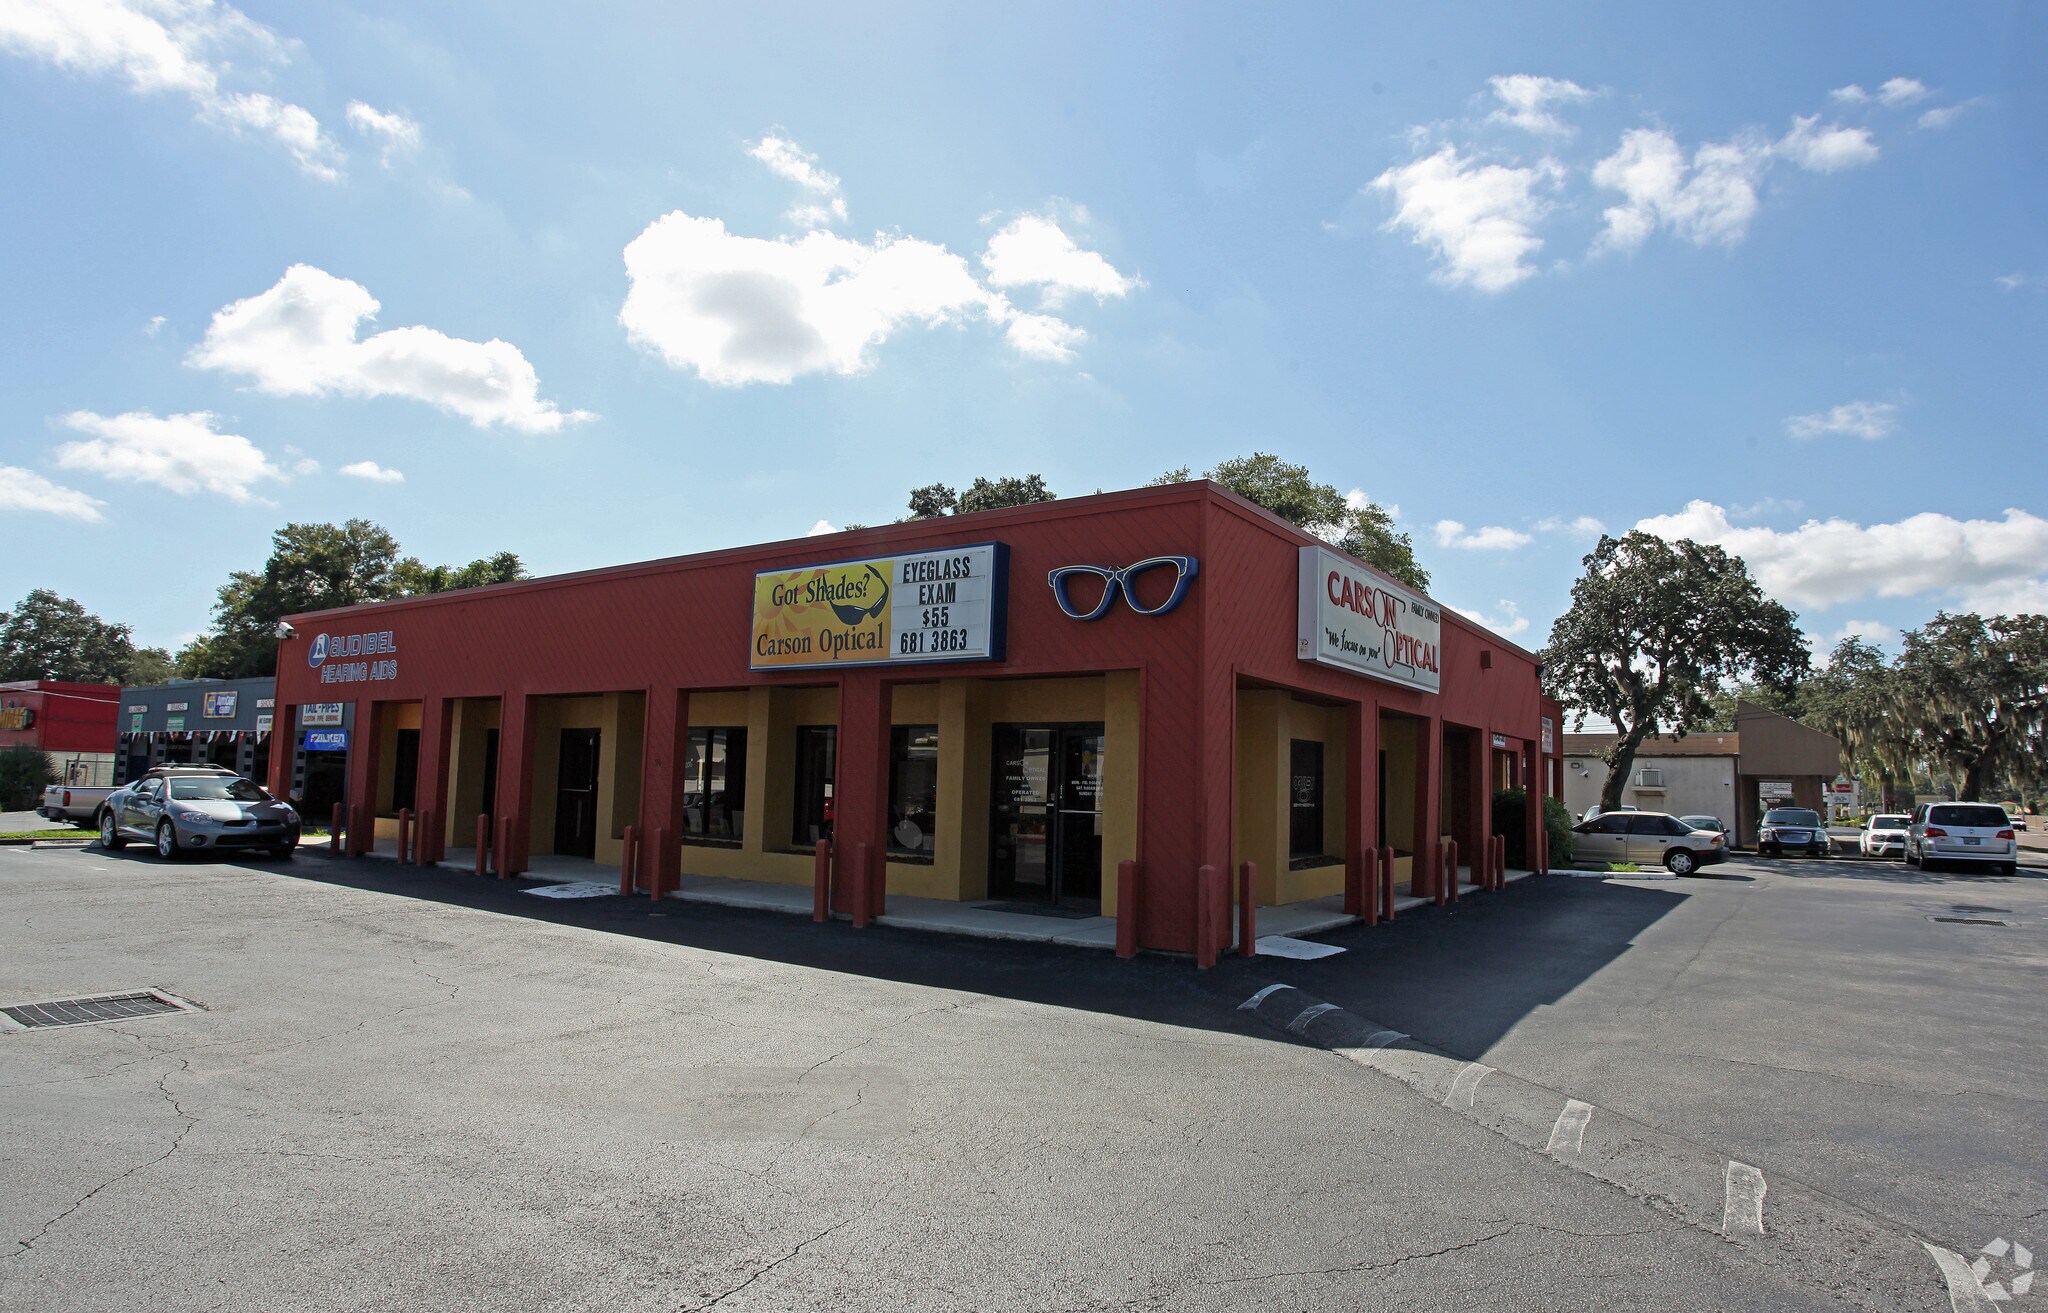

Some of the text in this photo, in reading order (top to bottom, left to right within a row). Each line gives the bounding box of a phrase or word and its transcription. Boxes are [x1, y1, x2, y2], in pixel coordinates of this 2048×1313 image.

[903, 556, 971, 583] EYEGLASS
[772, 573, 871, 607] Got Shades?
[919, 582, 956, 605] EXAM
[1327, 570, 1397, 629] CARSON
[922, 606, 949, 628] $55
[1411, 601, 1439, 625] FAMILY OWNED
[757, 621, 884, 660] Carson Optical
[900, 628, 968, 654] 681 3863
[1340, 628, 1358, 652] focus
[1358, 645, 1366, 656] on
[1384, 629, 1439, 674] OPTICAL
[321, 659, 398, 684] HEARING AIDS
